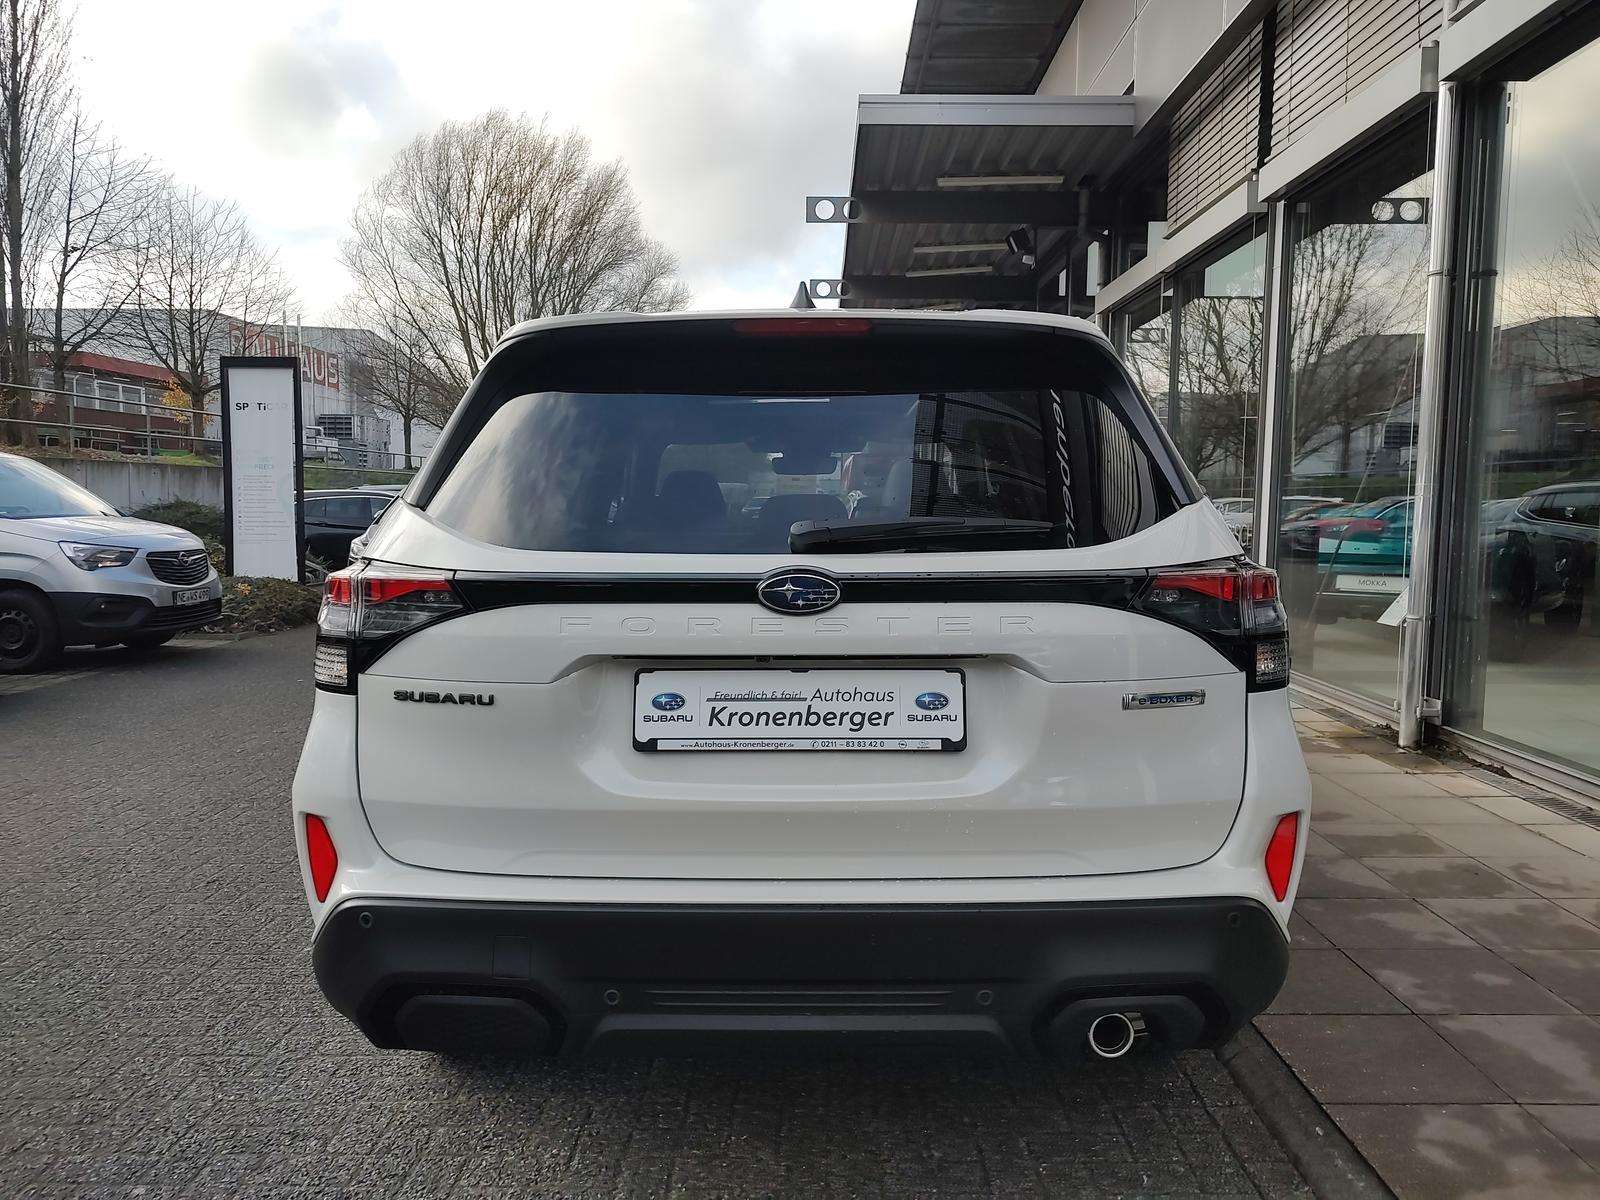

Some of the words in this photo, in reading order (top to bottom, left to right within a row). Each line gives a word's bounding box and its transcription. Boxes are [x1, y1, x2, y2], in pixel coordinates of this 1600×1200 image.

[1358, 579, 1388, 587] MOKKA
[559, 615, 1035, 636] FORESTER
[393, 690, 495, 706] SUBARU
[714, 690, 768, 700] Freundlich
[770, 691, 778, 700] &
[810, 687, 895, 702] Autohaus
[643, 714, 694, 723] SUBARU
[708, 704, 895, 732] Kronenberger
[907, 714, 958, 722] SUBARU
[680, 740, 795, 749] www.Autohaus-Kronenberger.de
